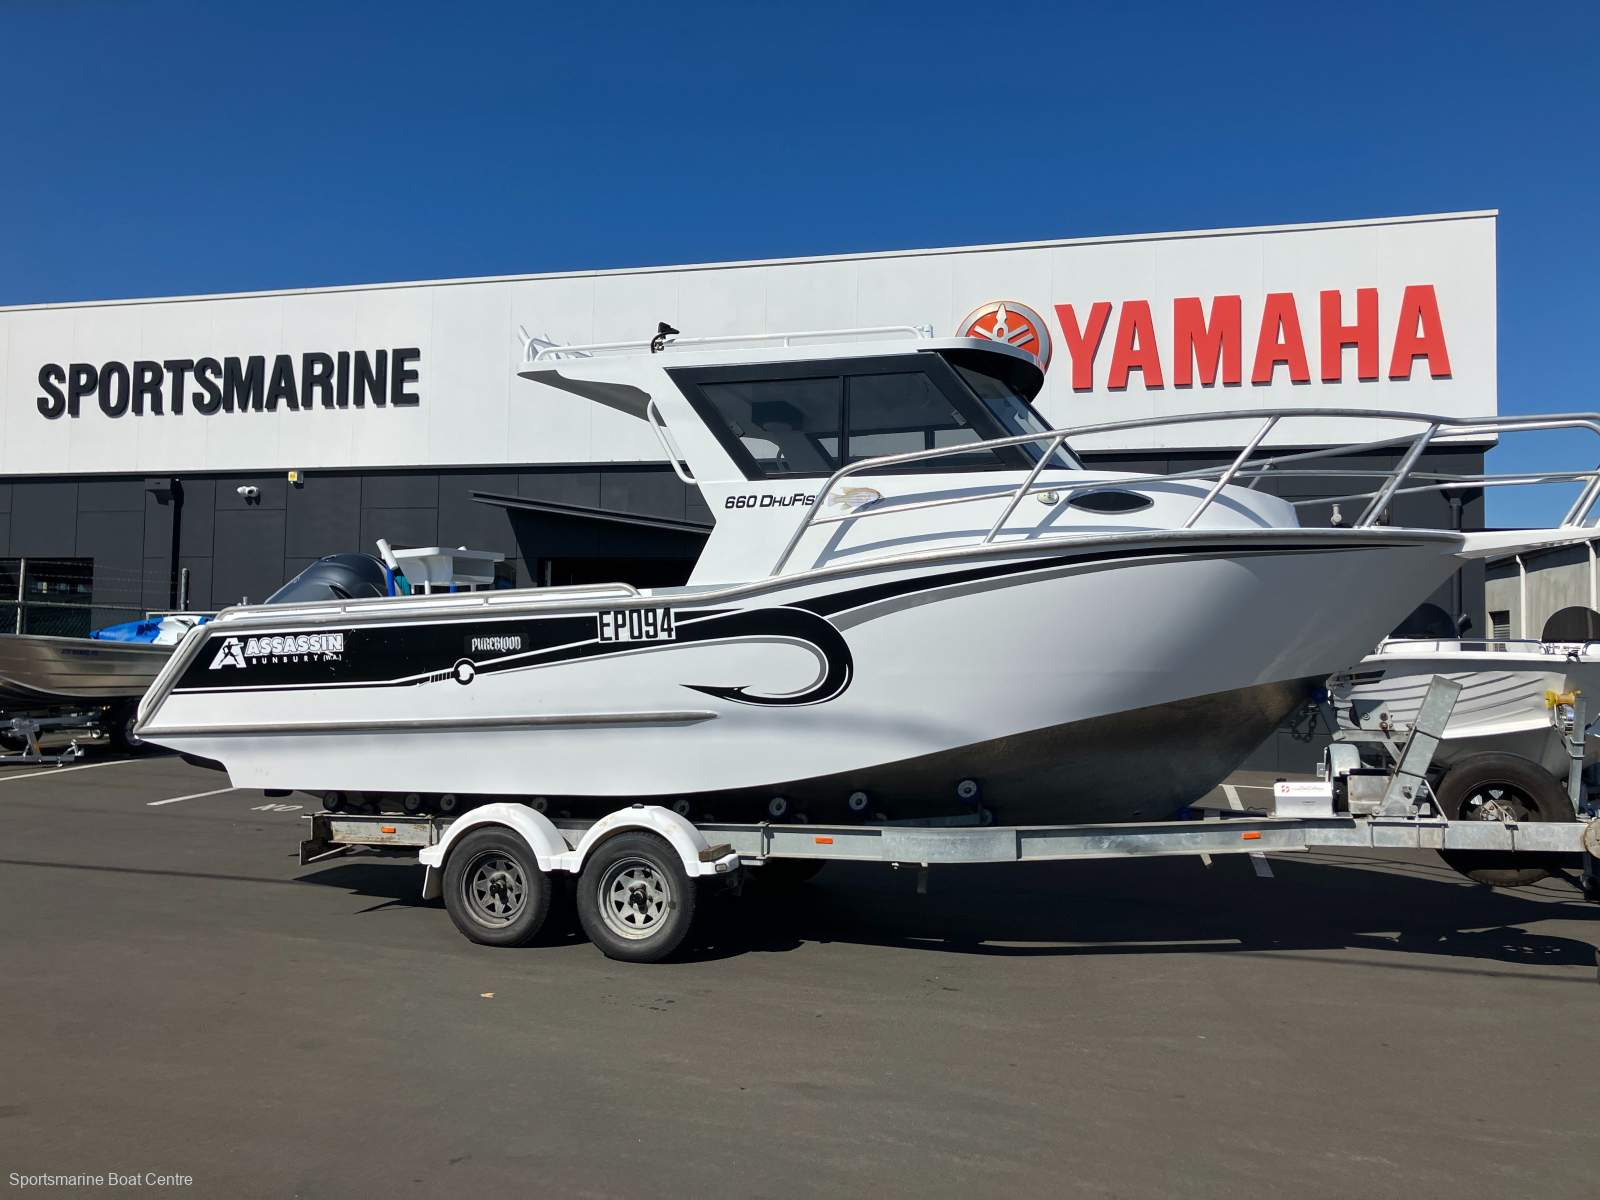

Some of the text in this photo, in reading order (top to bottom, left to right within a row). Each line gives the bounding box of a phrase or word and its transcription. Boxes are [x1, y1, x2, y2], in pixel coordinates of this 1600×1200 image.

[1055, 284, 1452, 393] YAMAHA
[37, 347, 421, 418] SPORTSMARINE
[725, 495, 757, 509] 660
[598, 608, 674, 641] EP094
[244, 633, 344, 657] ASSASSIN
[252, 655, 319, 665] BUNBURY
